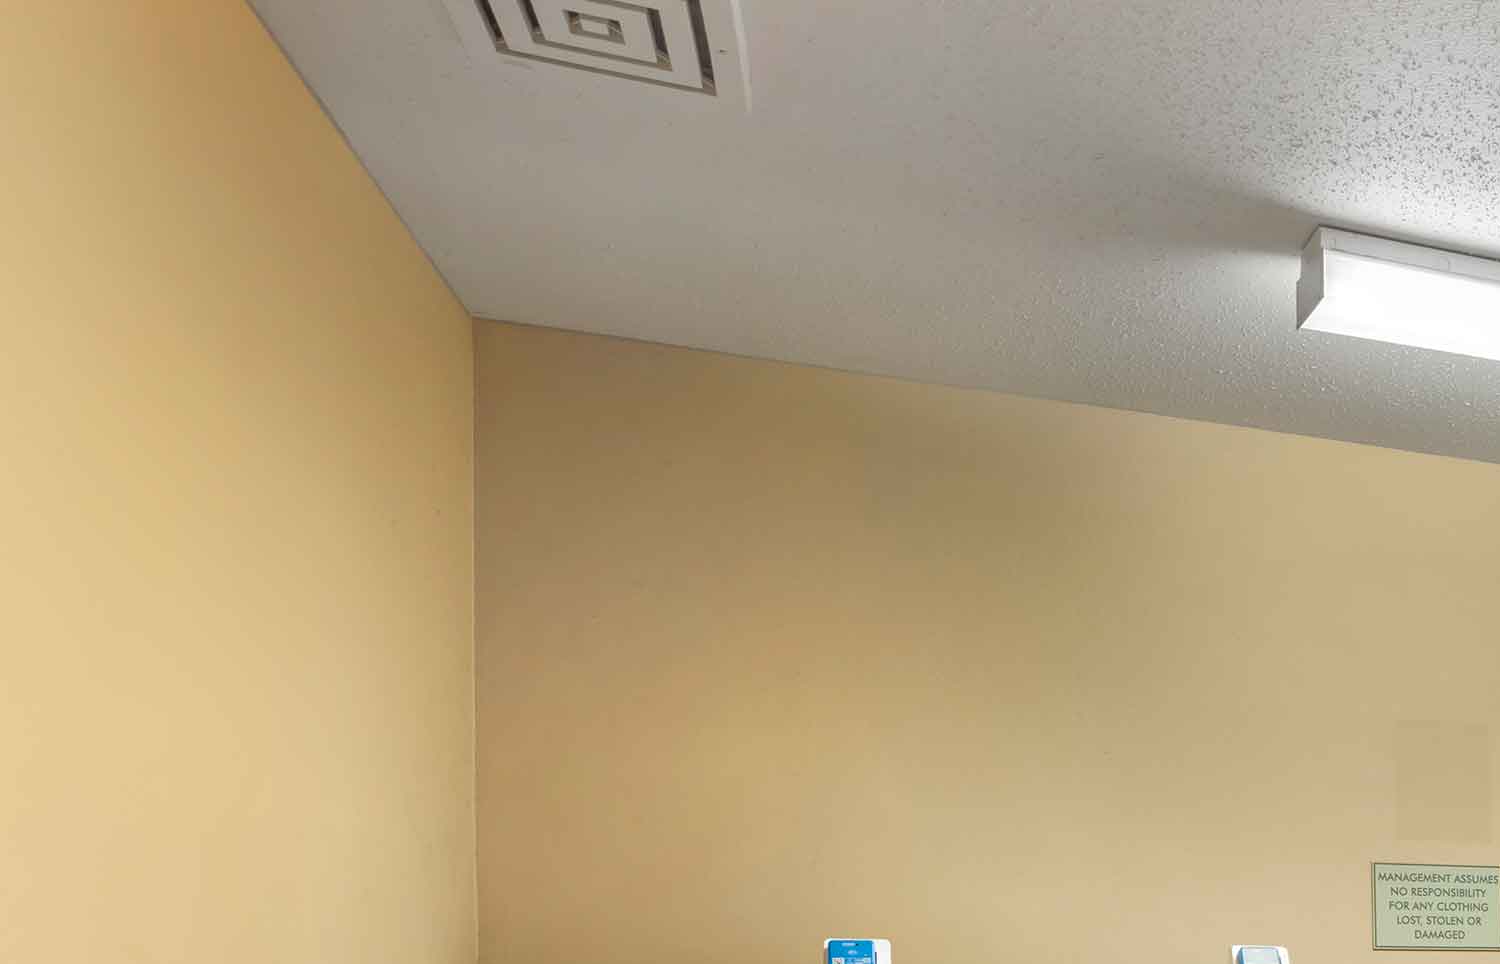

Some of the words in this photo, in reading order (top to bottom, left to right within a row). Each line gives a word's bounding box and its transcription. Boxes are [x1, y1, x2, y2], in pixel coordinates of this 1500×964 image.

[1377, 872, 1451, 883] MANAGEMENT
[1454, 874, 1499, 885] ASSUMES
[1390, 886, 1408, 897] NO
[1411, 887, 1487, 898] RESPONSIBILITY
[1388, 900, 1410, 911] FOR
[1411, 901, 1434, 911] ANY
[1436, 902, 1489, 912] CLOTHING
[1396, 915, 1423, 927] LOST,
[1426, 915, 1464, 926] STOLEN
[1466, 916, 1482, 926] OR
[1414, 930, 1466, 940] DAMAGED
